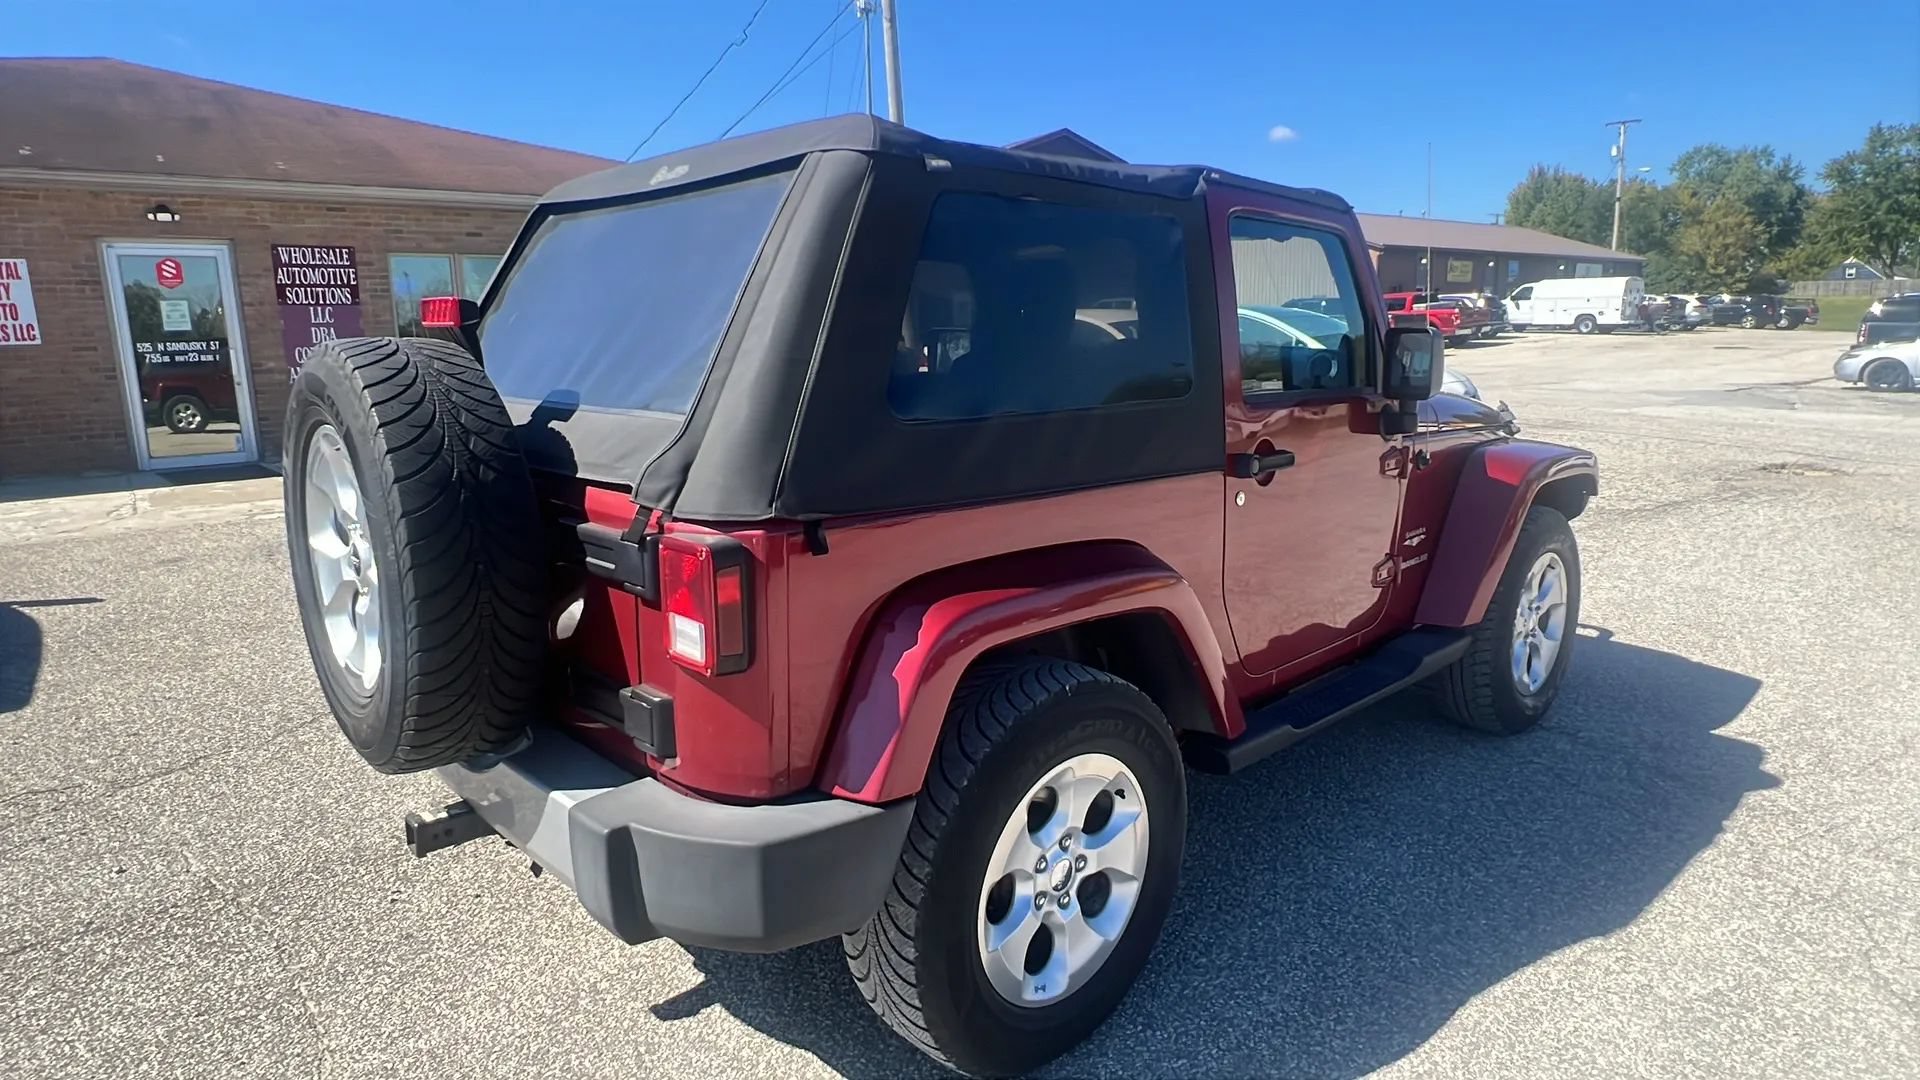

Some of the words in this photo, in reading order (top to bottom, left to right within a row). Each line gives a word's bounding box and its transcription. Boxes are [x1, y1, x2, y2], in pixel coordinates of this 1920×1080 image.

[277, 246, 351, 266] WHOLESALE
[276, 267, 357, 285] AUTOMOTIVE
[285, 287, 352, 305] SOLUTIONS
[0, 303, 19, 321] TO
[309, 306, 335, 324] LLC
[0, 323, 11, 342] S
[12, 323, 37, 342] LLC
[311, 326, 337, 344] DBA
[136, 342, 153, 352] 525
[157, 342, 165, 352] N
[166, 341, 207, 351] SANDUSKY
[210, 341, 220, 350] ST
[295, 346, 313, 364] CO
[144, 353, 162, 363] 755
[289, 366, 301, 384] A
